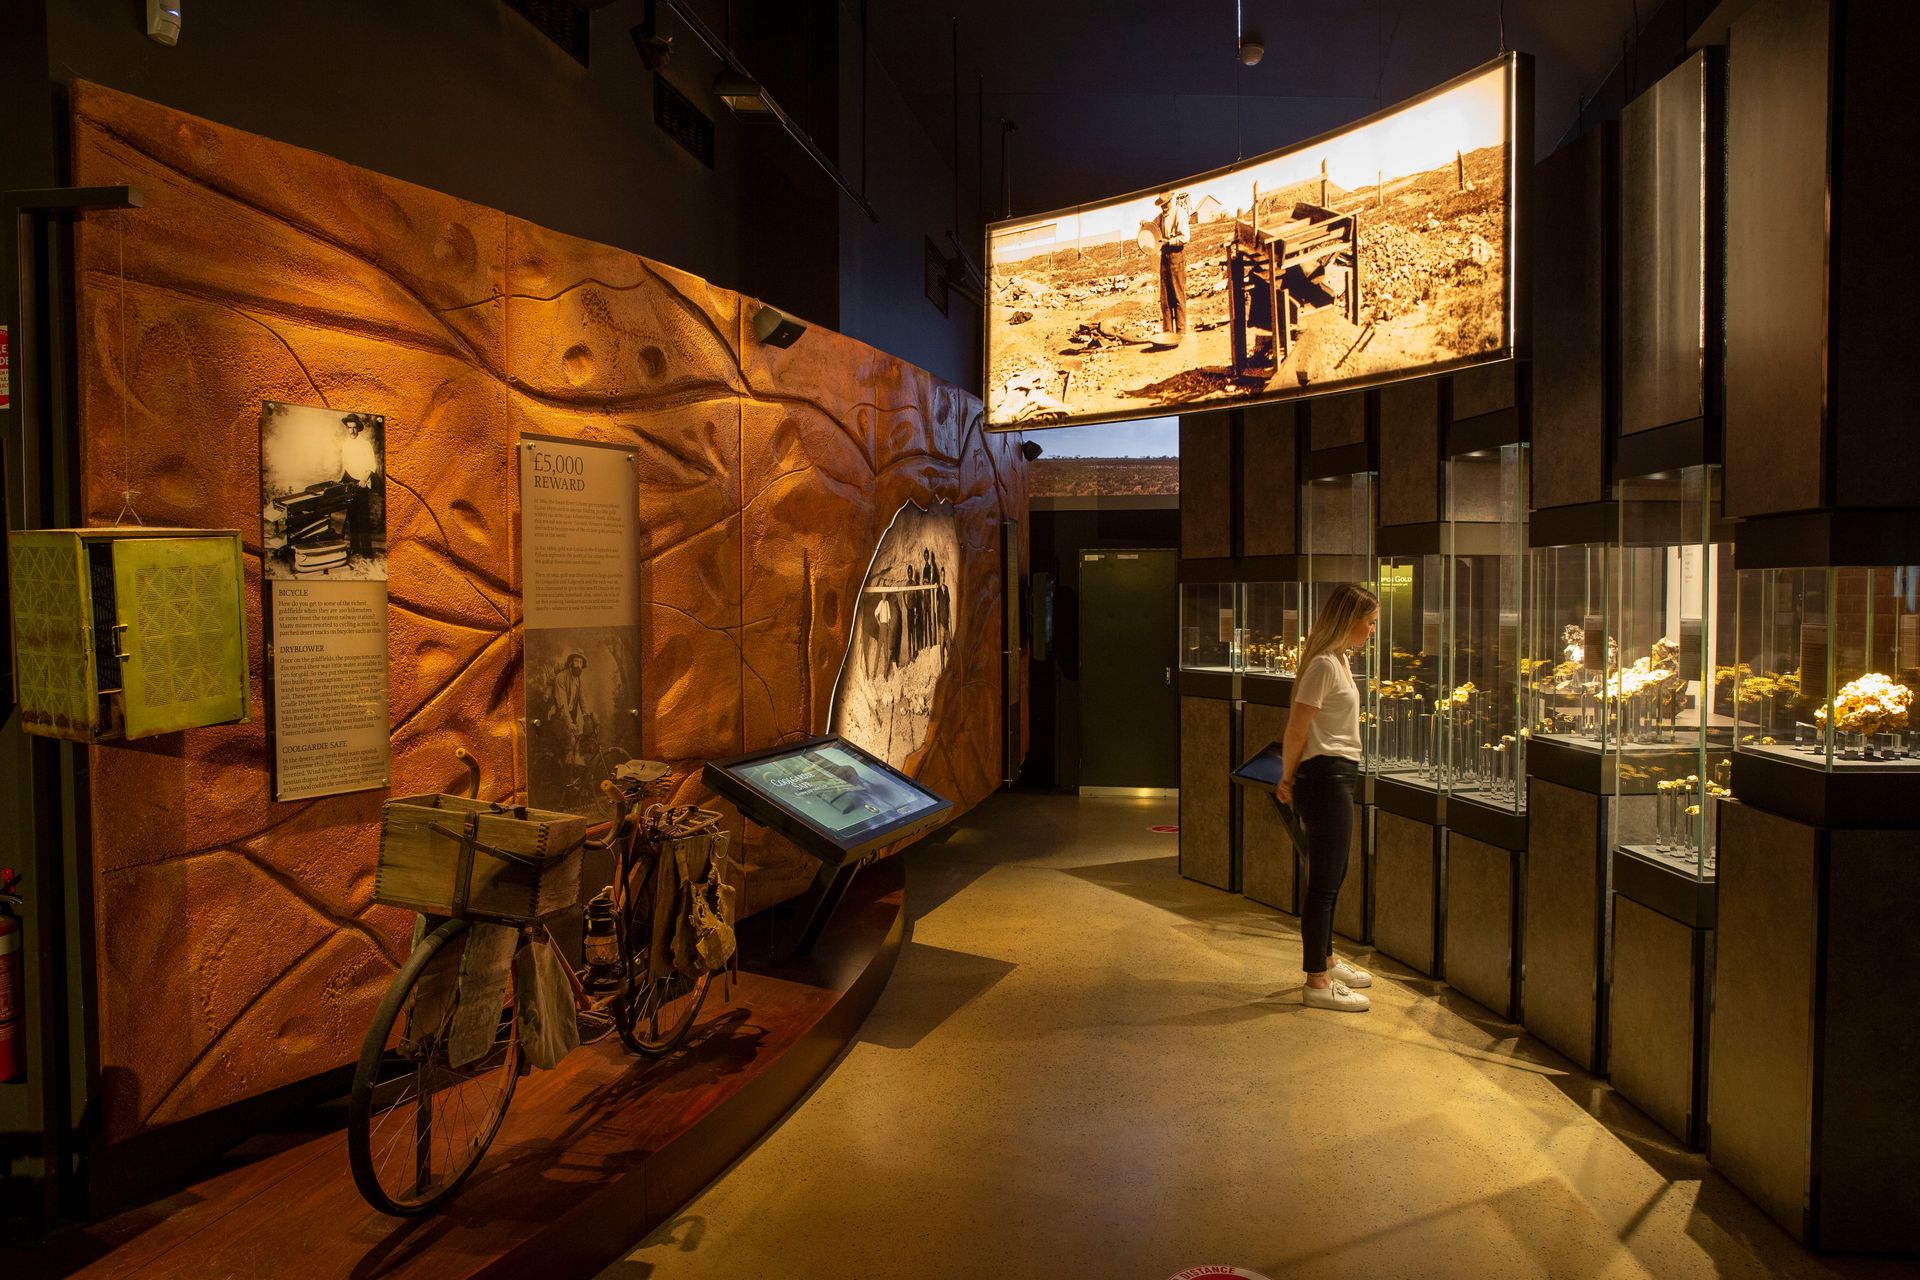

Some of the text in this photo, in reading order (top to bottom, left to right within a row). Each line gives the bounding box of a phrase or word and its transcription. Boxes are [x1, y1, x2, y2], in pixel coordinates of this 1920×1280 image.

[533, 452, 584, 476] £5,000
[534, 476, 585, 491] REWARD
[280, 645, 324, 653] DRYBLOWER
[283, 743, 328, 753] COOLGARDIE
[770, 773, 816, 786] COOLGARDIE
[1181, 1266, 1236, 1280] DISTANCE
